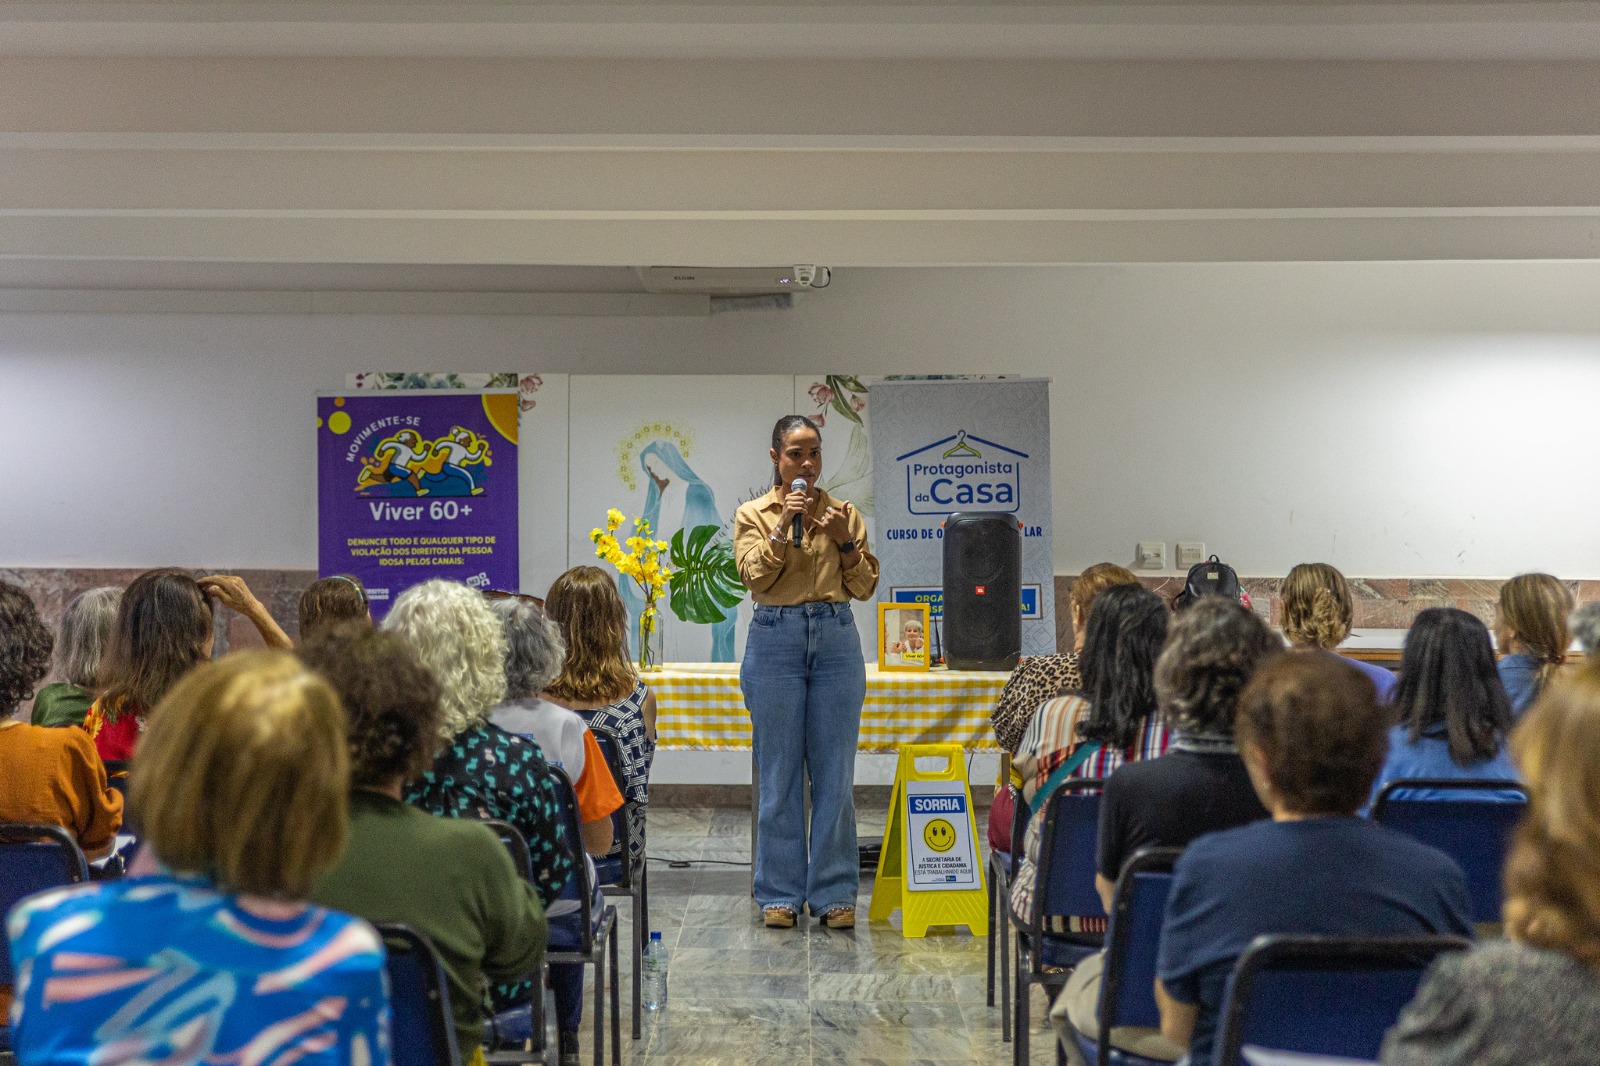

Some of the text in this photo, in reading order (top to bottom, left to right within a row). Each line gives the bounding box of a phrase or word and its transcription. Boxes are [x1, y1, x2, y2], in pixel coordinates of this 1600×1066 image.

[345, 415, 421, 463] MOVIMENTE-SE
[913, 460, 1013, 479] Protagonista
[914, 478, 1014, 505] da Casa
[369, 501, 473, 520] Viver 60+
[886, 529, 918, 540] CURSO
[921, 528, 934, 539] DE
[1024, 526, 1043, 537] LAR
[347, 535, 496, 546] DENUNCIE TODO E QUALQUER TIPO DE
[350, 546, 493, 557] VIOLAÇÃO DOS DIREITOS DA PESSOA
[379, 556, 465, 566] IDOSA PELOS CANAIS:
[914, 594, 944, 603] ORGA
[915, 799, 960, 811] SORRIA
